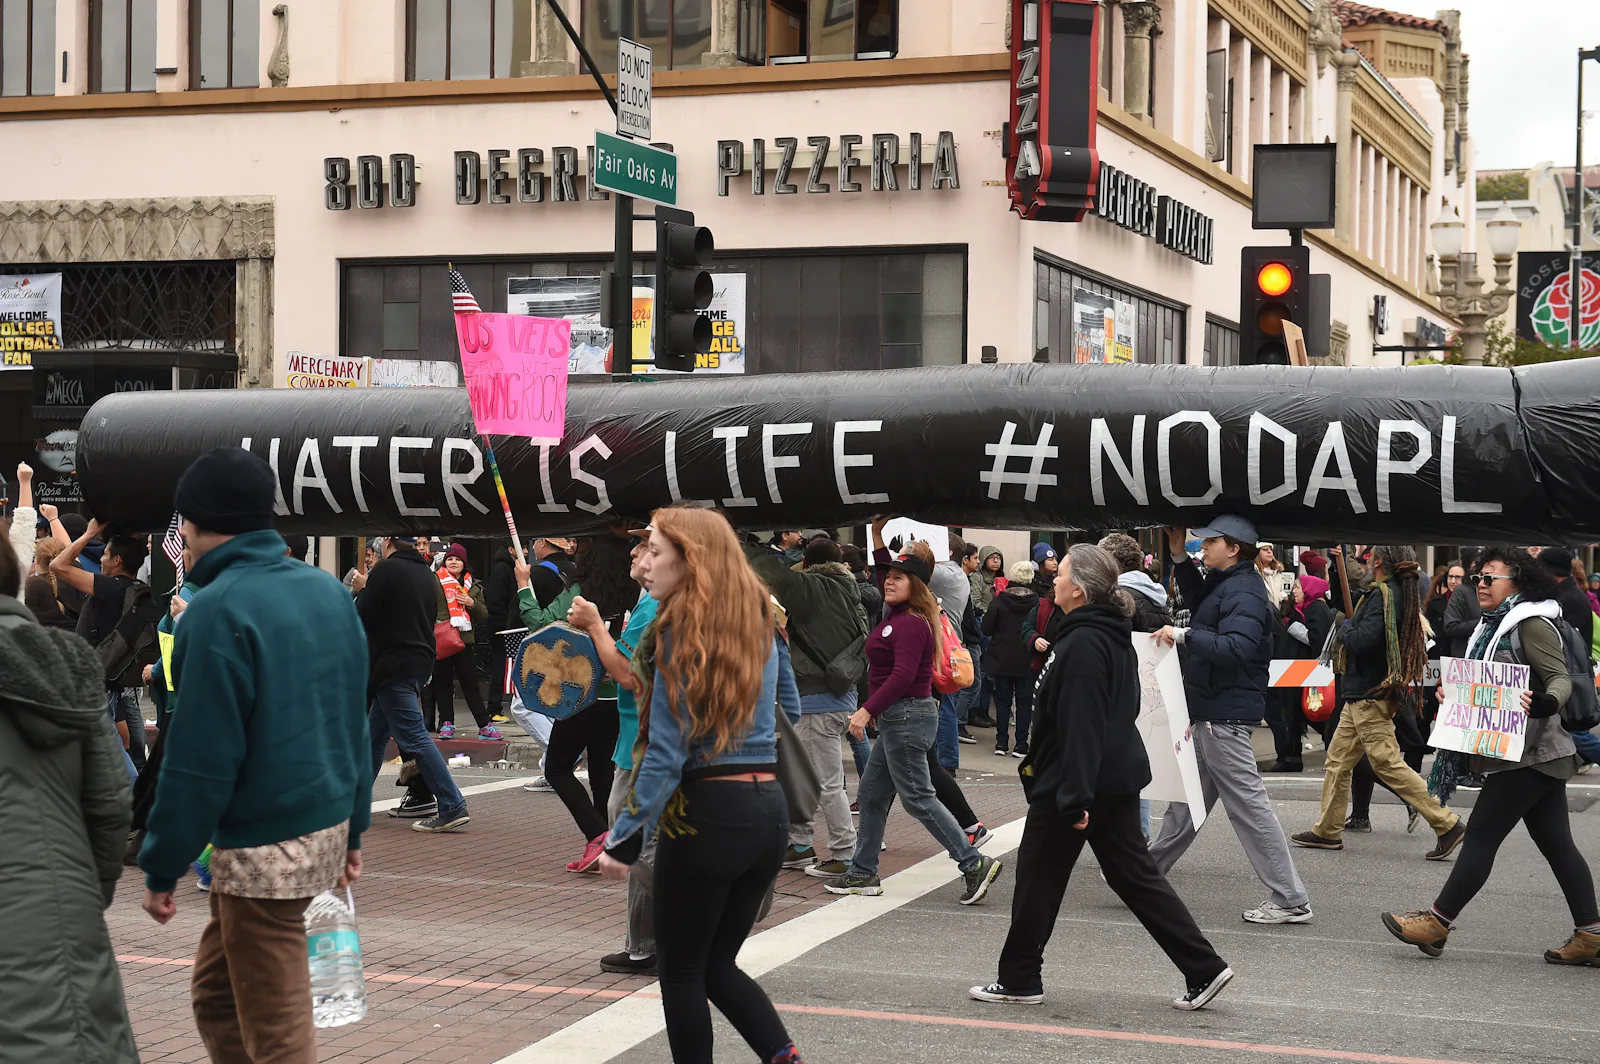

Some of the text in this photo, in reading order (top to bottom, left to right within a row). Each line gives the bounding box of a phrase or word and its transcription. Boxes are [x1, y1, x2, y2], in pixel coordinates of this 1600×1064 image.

[621, 52, 650, 80] DO NOT
[620, 82, 650, 110] BLOCK
[620, 110, 650, 130] INTERSECTION
[324, 153, 416, 210] 800
[717, 131, 960, 196] PIZZERIA
[598, 148, 675, 190] Fair Oaks Av
[1099, 161, 1158, 238] DEGREES
[1521, 258, 1564, 299] ROSE
[20, 287, 47, 299] Bowl
[0, 321, 53, 336] OLLEGE
[461, 313, 571, 359] US VETS
[288, 354, 363, 381] MERCENARY
[522, 360, 562, 374] WITH
[694, 353, 720, 369] NS
[53, 380, 84, 404] MECCA
[521, 374, 568, 423] ROCK
[528, 434, 613, 516] IS
[664, 420, 890, 508] LIFE
[35, 482, 62, 496] Rose
[1446, 659, 1475, 684] AN
[1480, 663, 1529, 689] INJURY
[1456, 683, 1513, 710] TO ONE IS
[1444, 703, 1527, 735] AN INJURY
[1461, 729, 1504, 757] TO ALL
